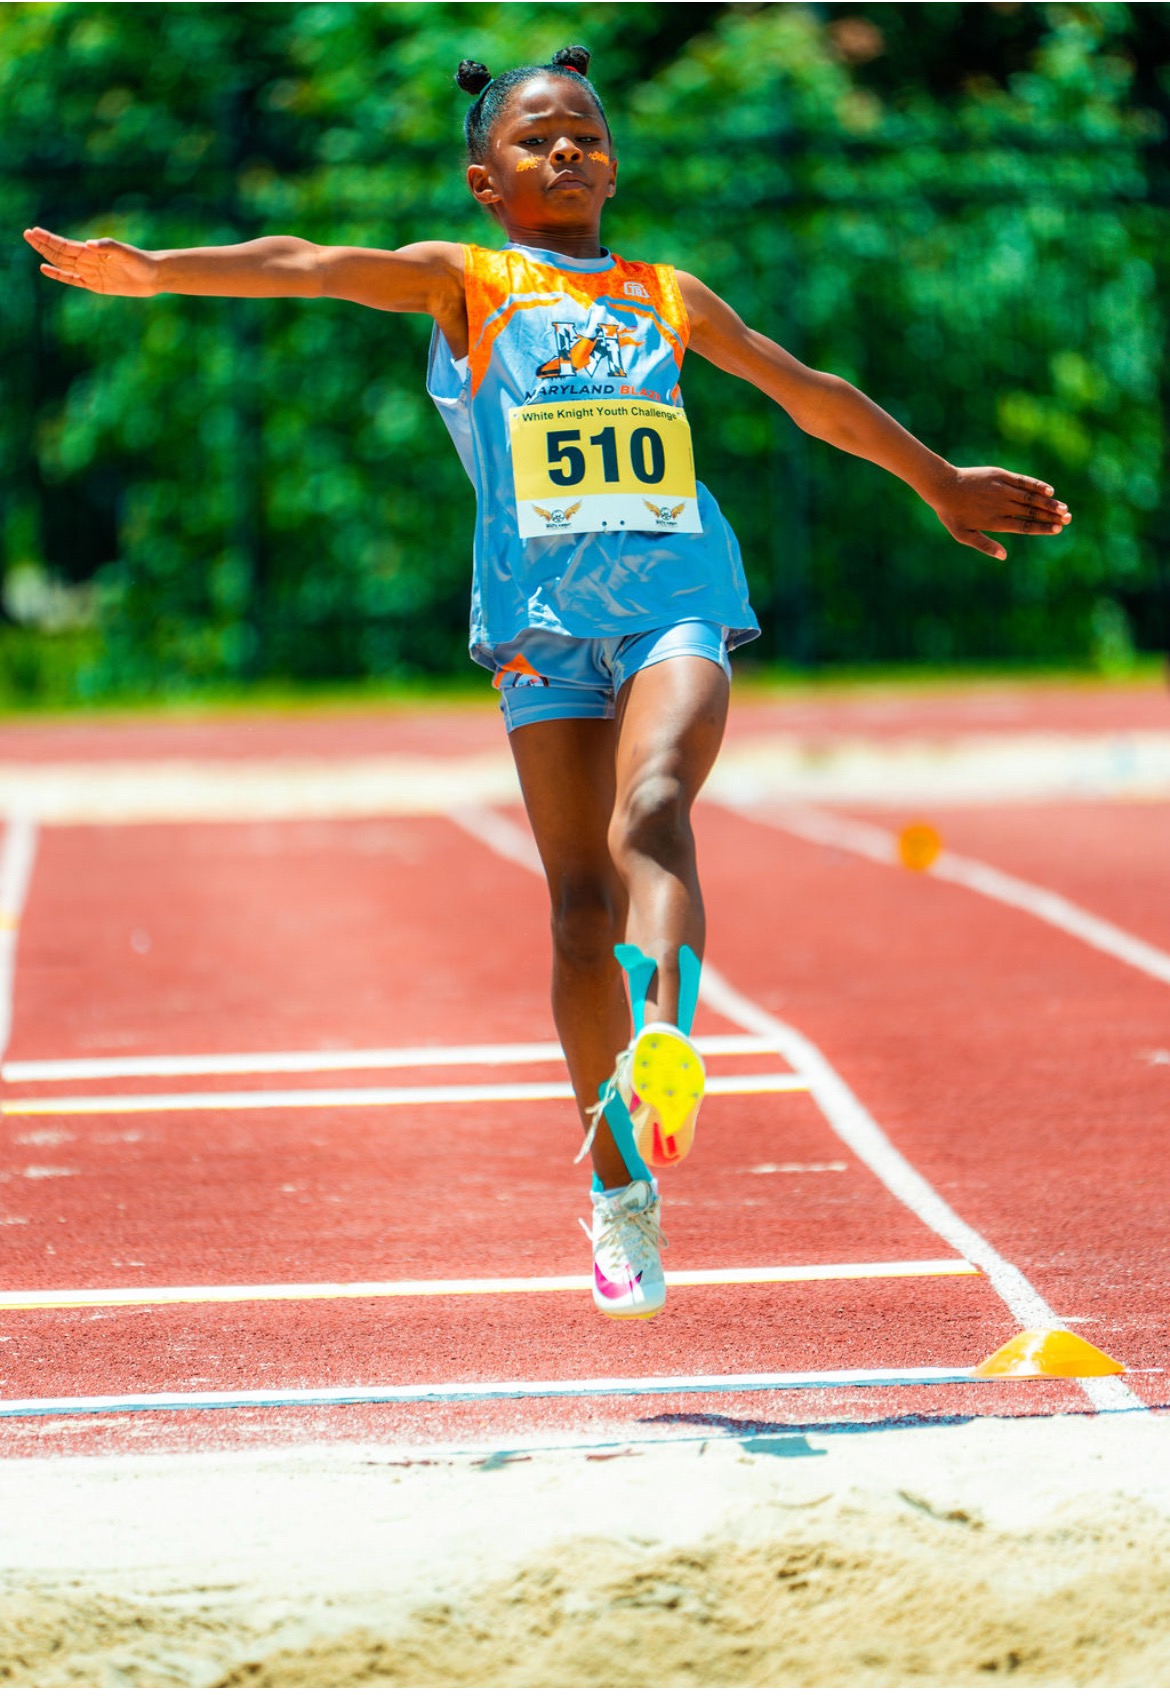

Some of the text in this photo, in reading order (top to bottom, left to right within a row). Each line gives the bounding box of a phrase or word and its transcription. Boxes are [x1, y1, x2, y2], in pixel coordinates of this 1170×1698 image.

[522, 406, 677, 422] White Knight Youth Challenge
[546, 426, 666, 487] 510
